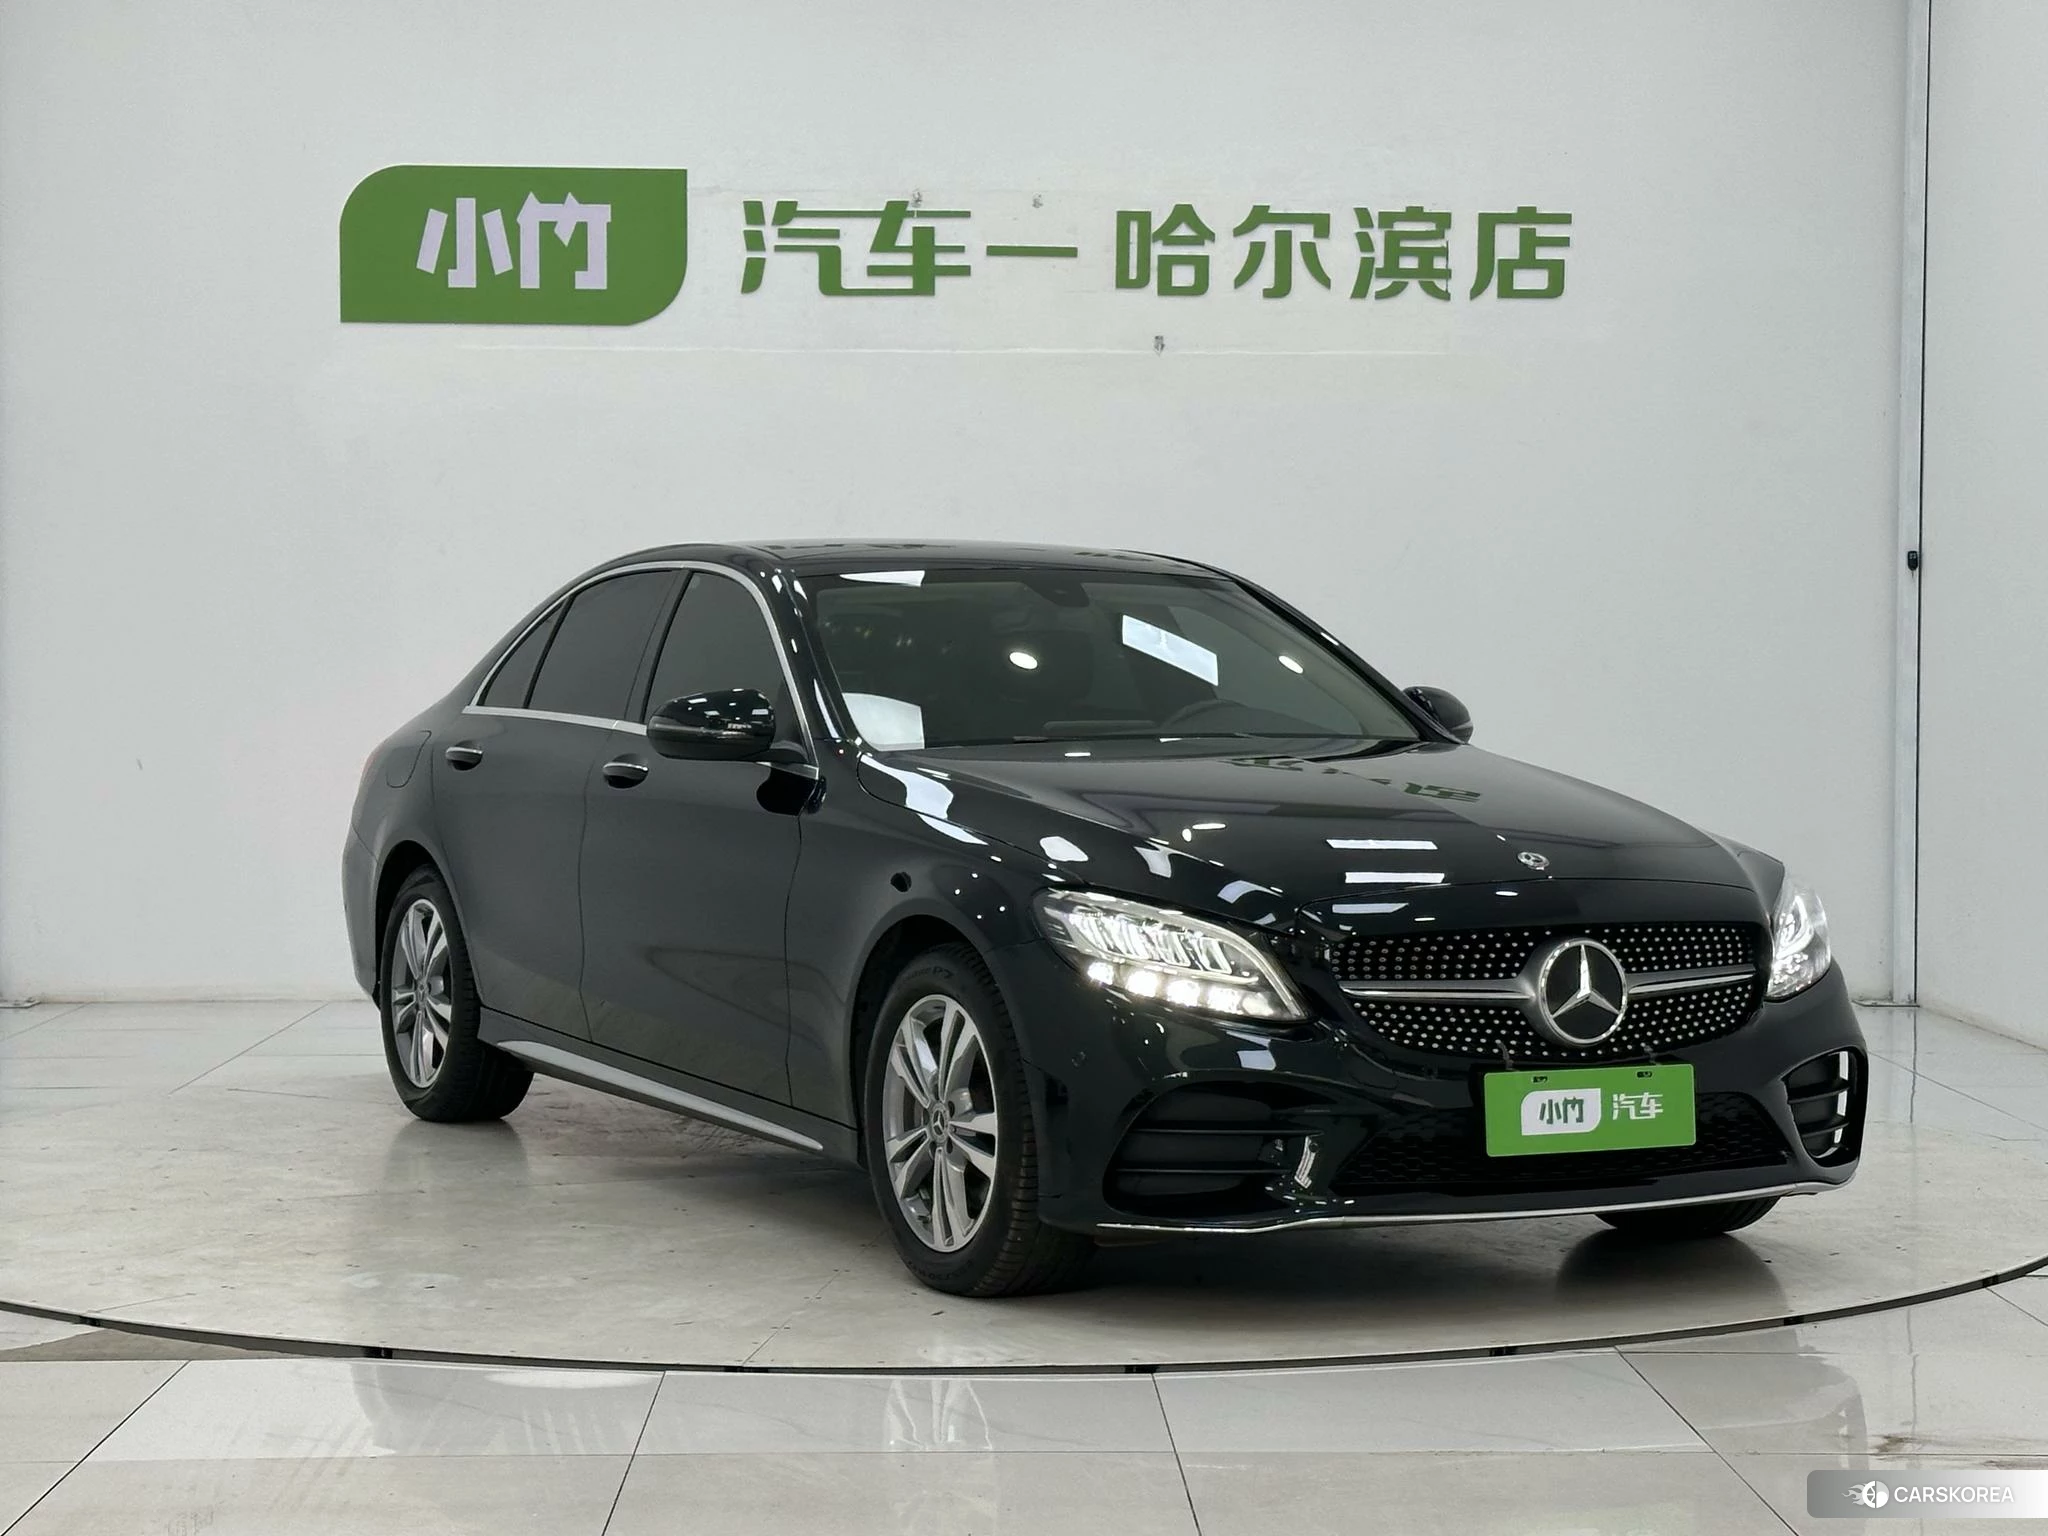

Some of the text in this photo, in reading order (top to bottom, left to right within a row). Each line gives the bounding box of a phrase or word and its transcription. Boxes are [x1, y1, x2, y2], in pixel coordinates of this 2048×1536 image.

[416, 191, 611, 289] 小竹
[1538, 1092, 1663, 1124] 小竹 汽车
